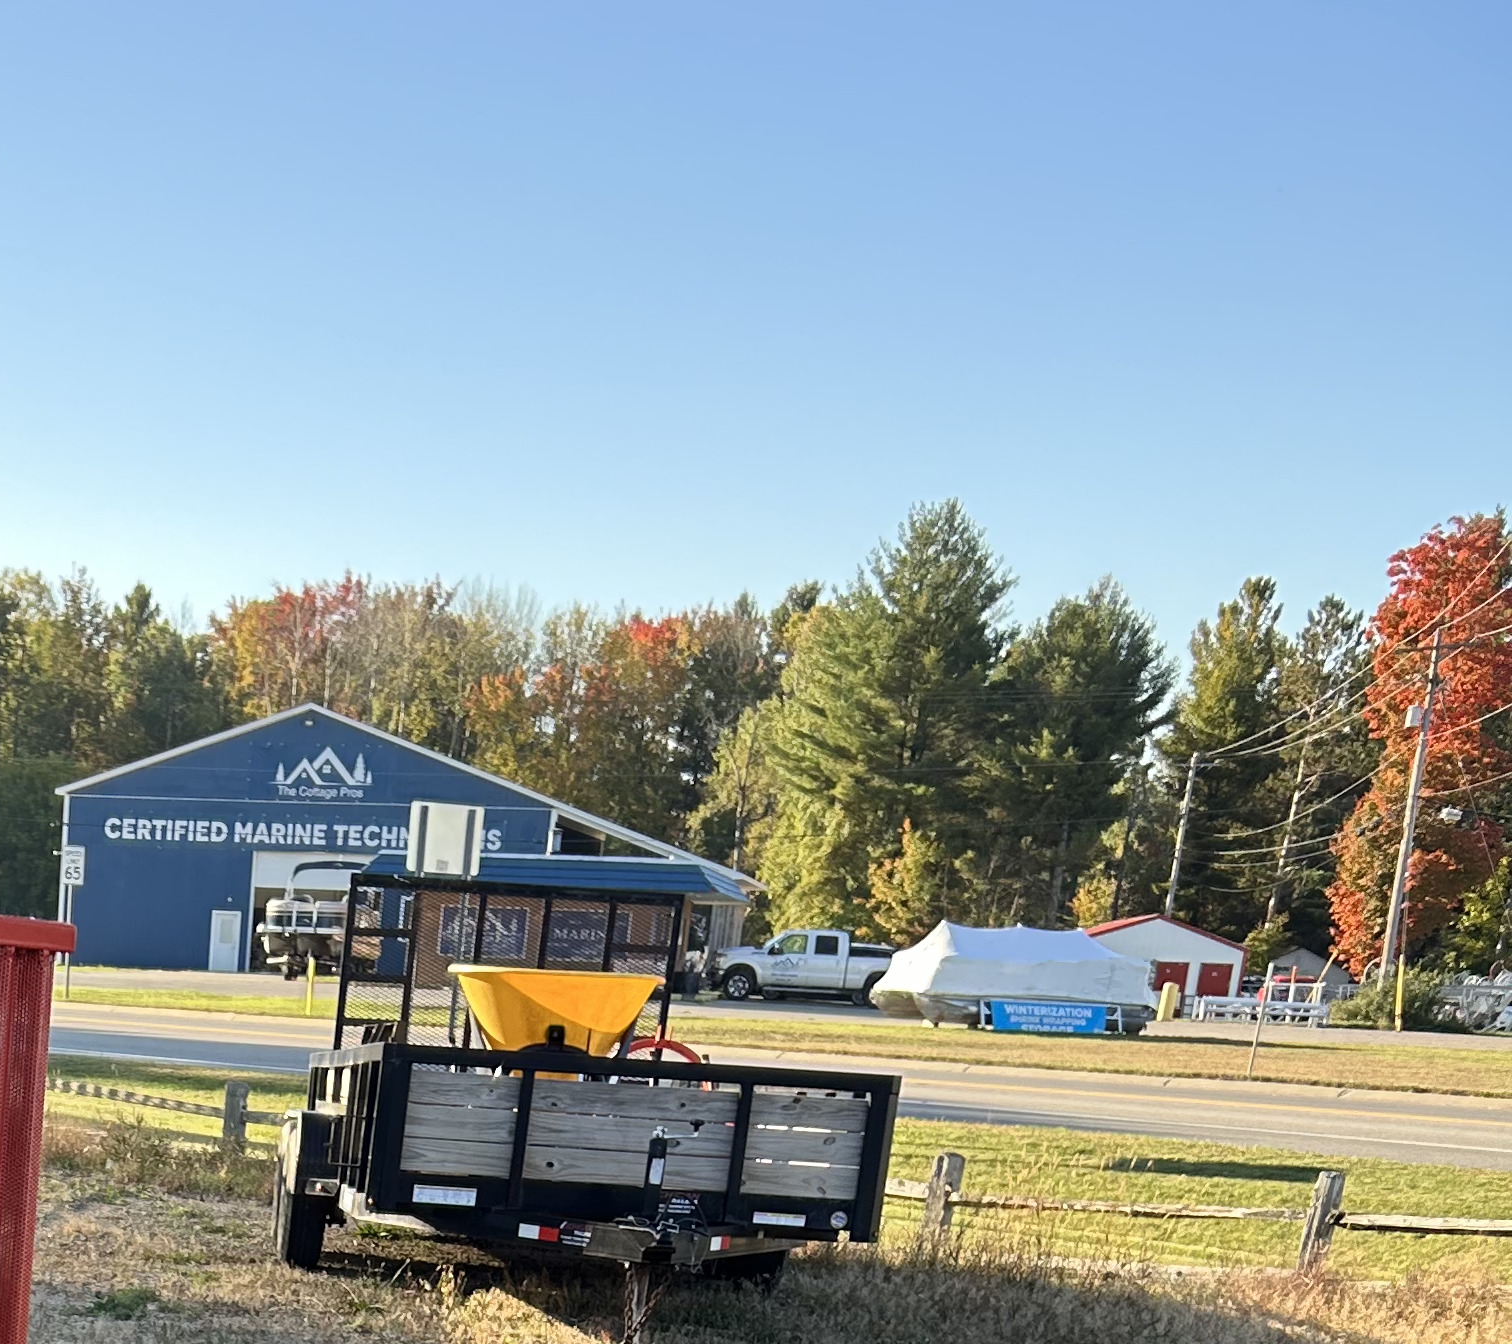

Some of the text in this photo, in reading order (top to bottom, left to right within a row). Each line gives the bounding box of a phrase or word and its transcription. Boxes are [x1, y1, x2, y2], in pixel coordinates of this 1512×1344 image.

[277, 785, 364, 799] The Cottage Pros
[104, 817, 503, 851] CERTIFIED MARINE TECHNS
[65, 866, 81, 880] 65
[1004, 1004, 1093, 1018] WINTERIZATION
